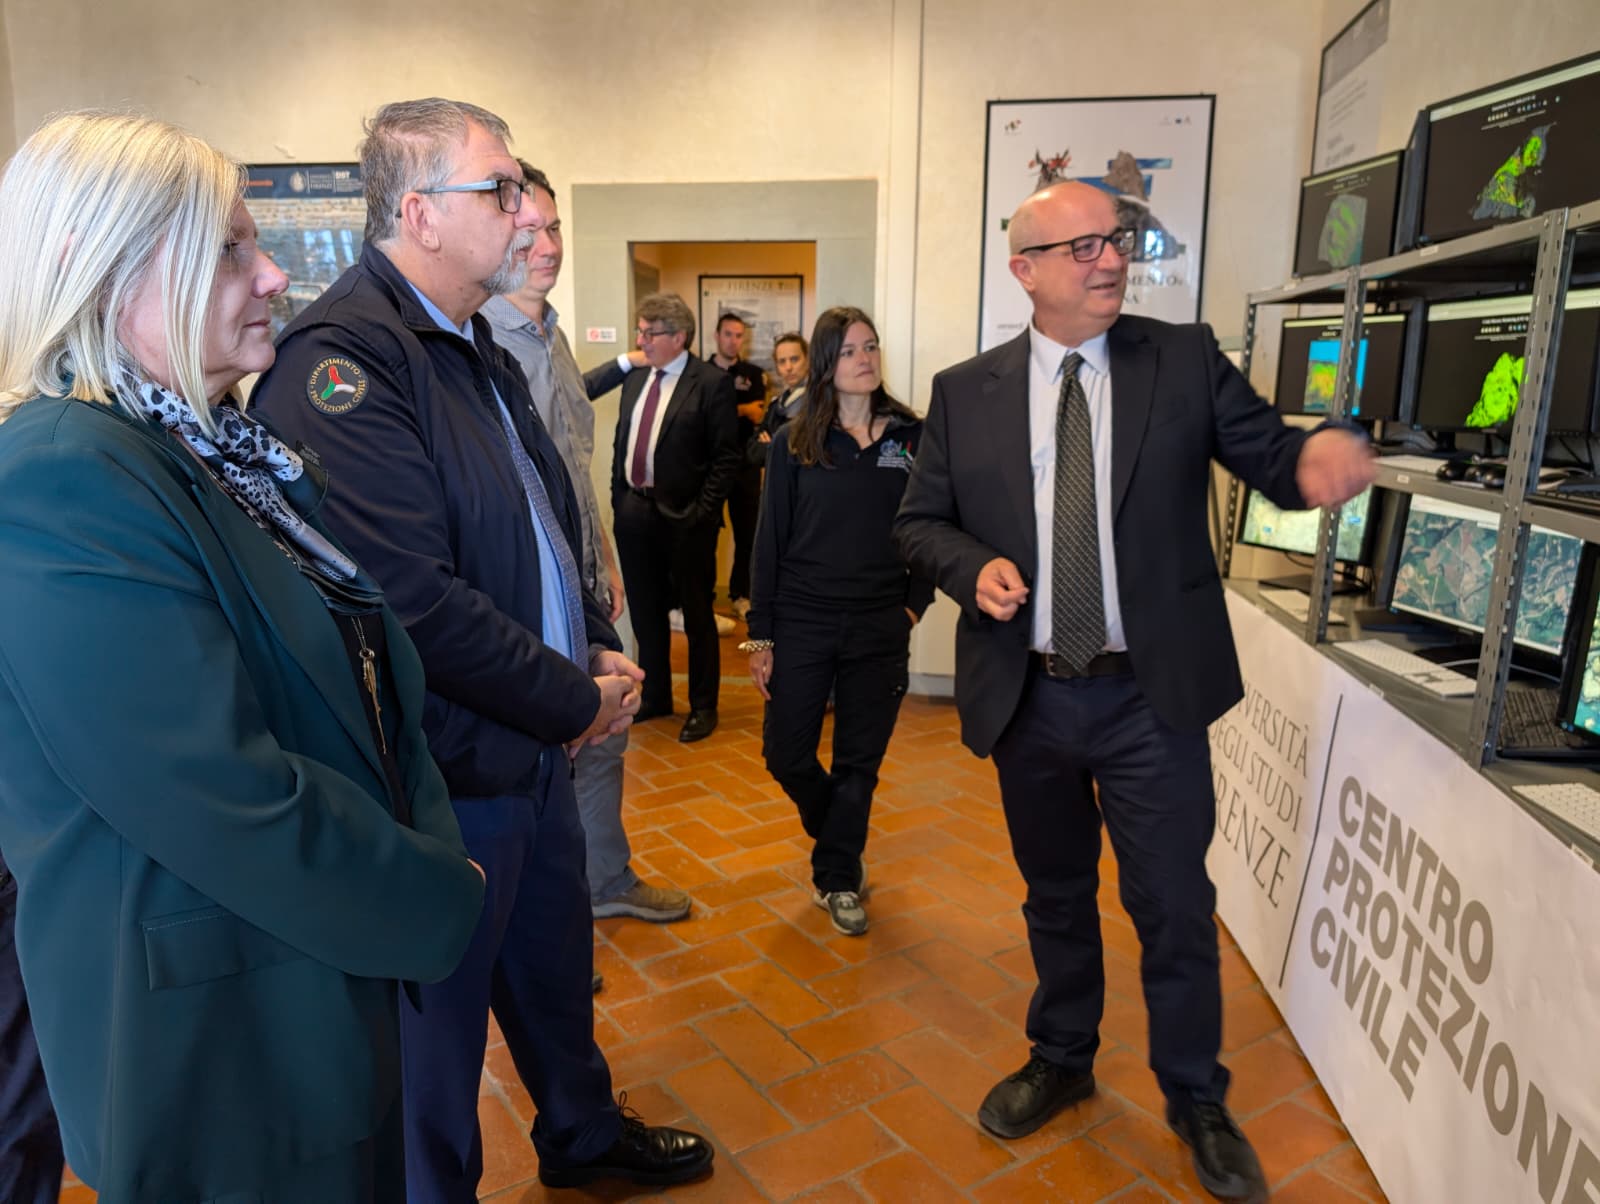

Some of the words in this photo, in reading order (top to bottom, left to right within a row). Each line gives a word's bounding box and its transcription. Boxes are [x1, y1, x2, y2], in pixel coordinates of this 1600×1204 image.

[310, 358, 361, 385] DIPARTIMENTO
[310, 389, 353, 412] PROTEZIONE
[352, 379, 366, 403] CIVILE
[1213, 766, 1292, 909] RENZE
[1246, 751, 1303, 833] STUDI
[1338, 775, 1494, 985] CENTRO
[1310, 906, 1428, 1103] CIVILE
